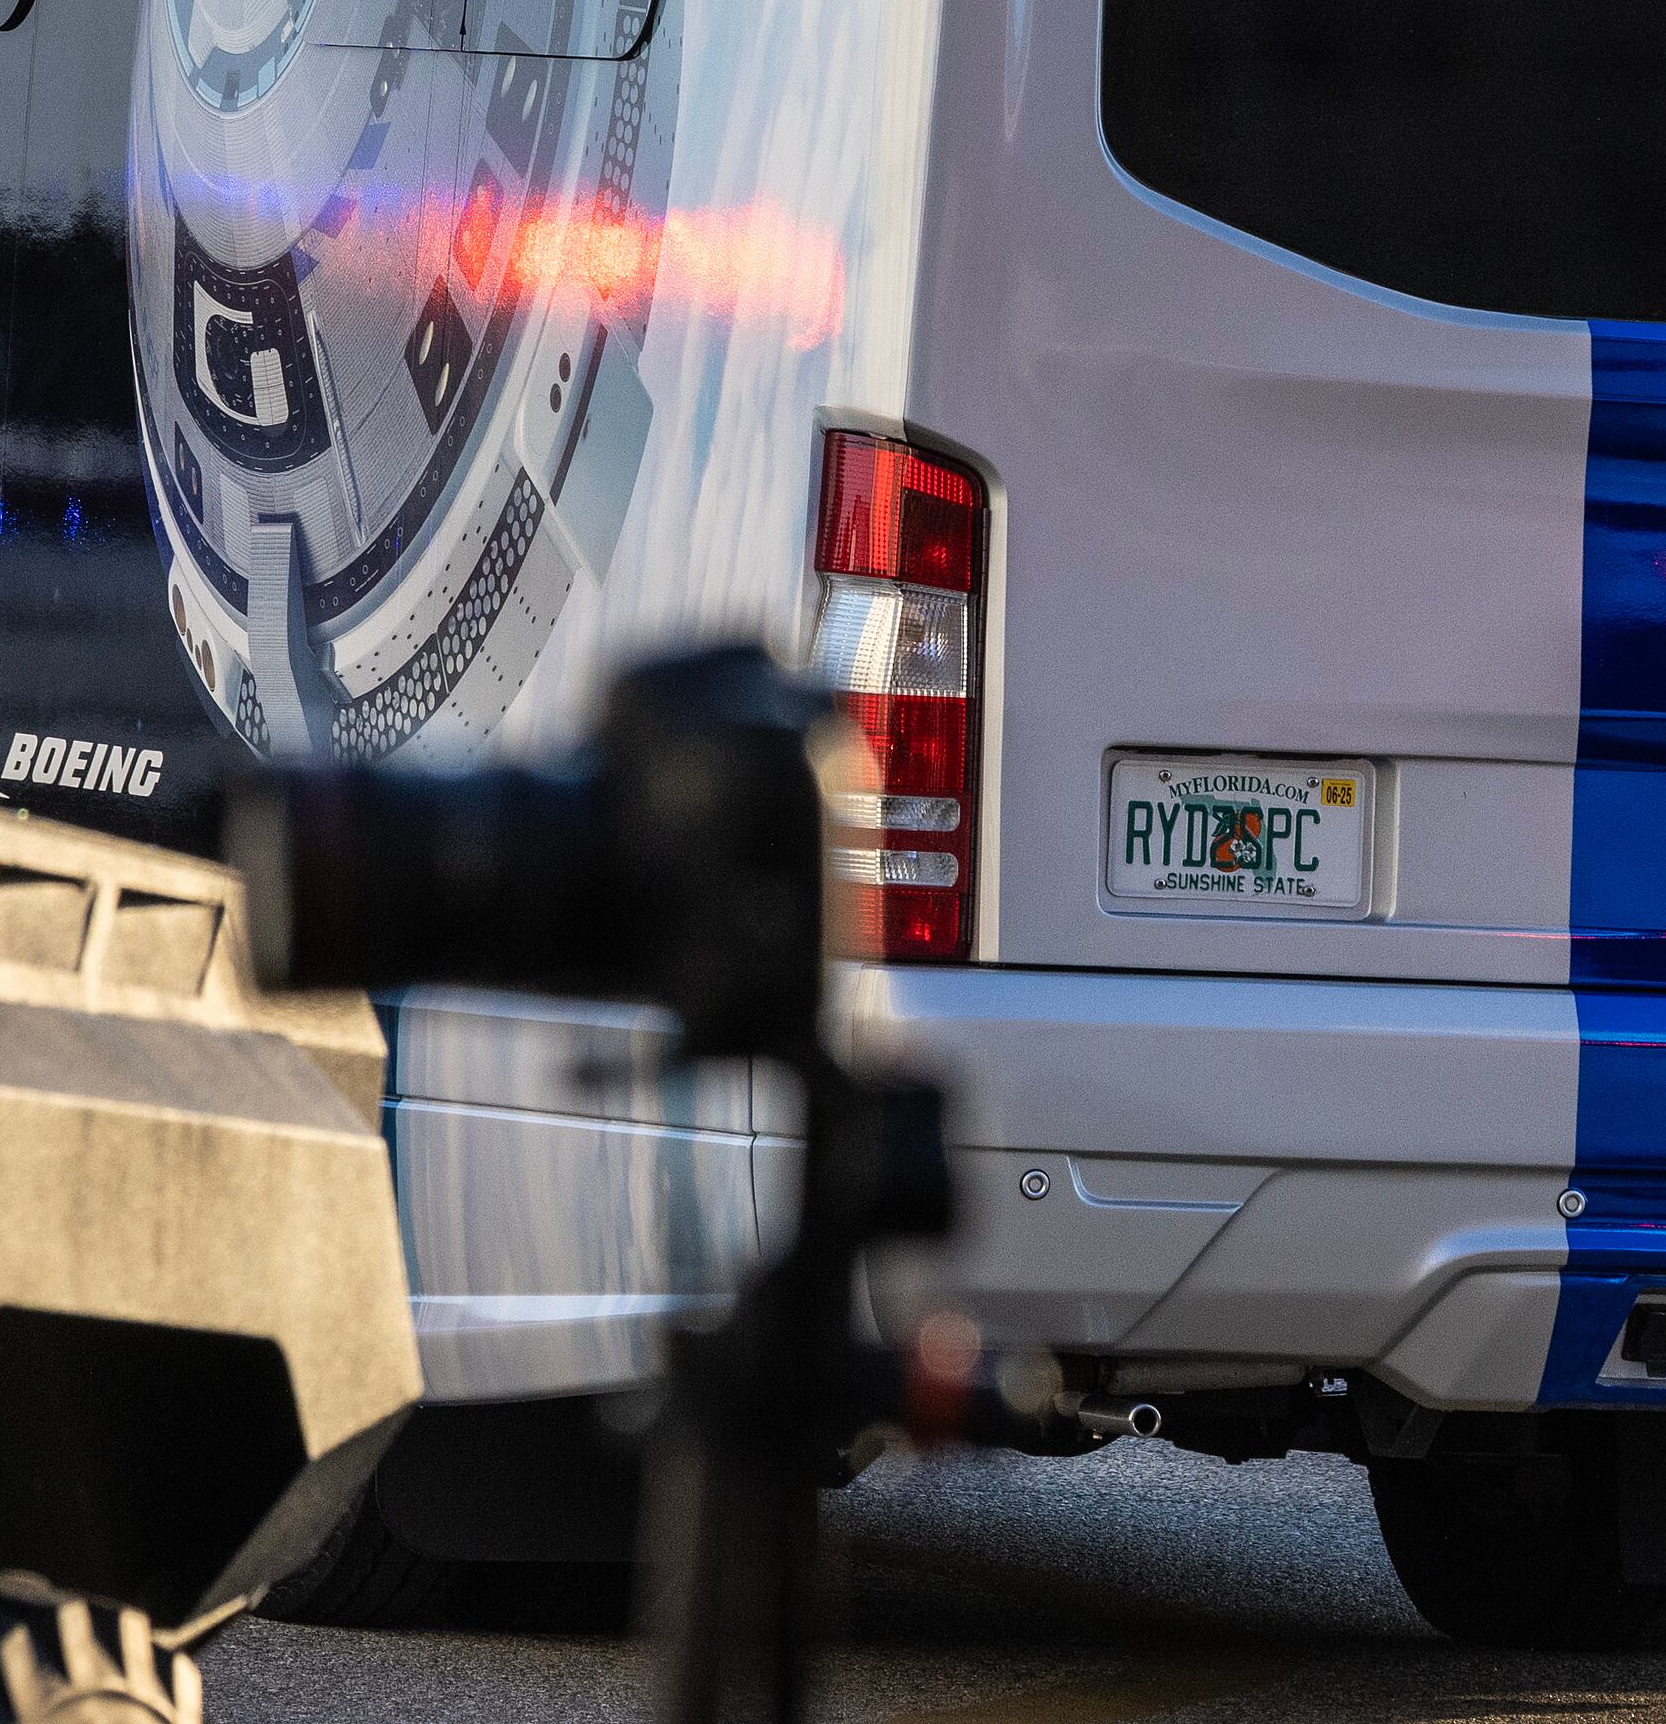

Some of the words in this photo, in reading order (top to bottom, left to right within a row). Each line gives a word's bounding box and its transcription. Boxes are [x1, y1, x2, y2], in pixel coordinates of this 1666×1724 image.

[1, 732, 163, 797] BOEING
[1169, 775, 1310, 804] MYFLORIDA.COM
[1326, 786, 1353, 805] 06-25
[1166, 872, 1245, 893] SUNSHINE
[1253, 876, 1306, 896] STATE
